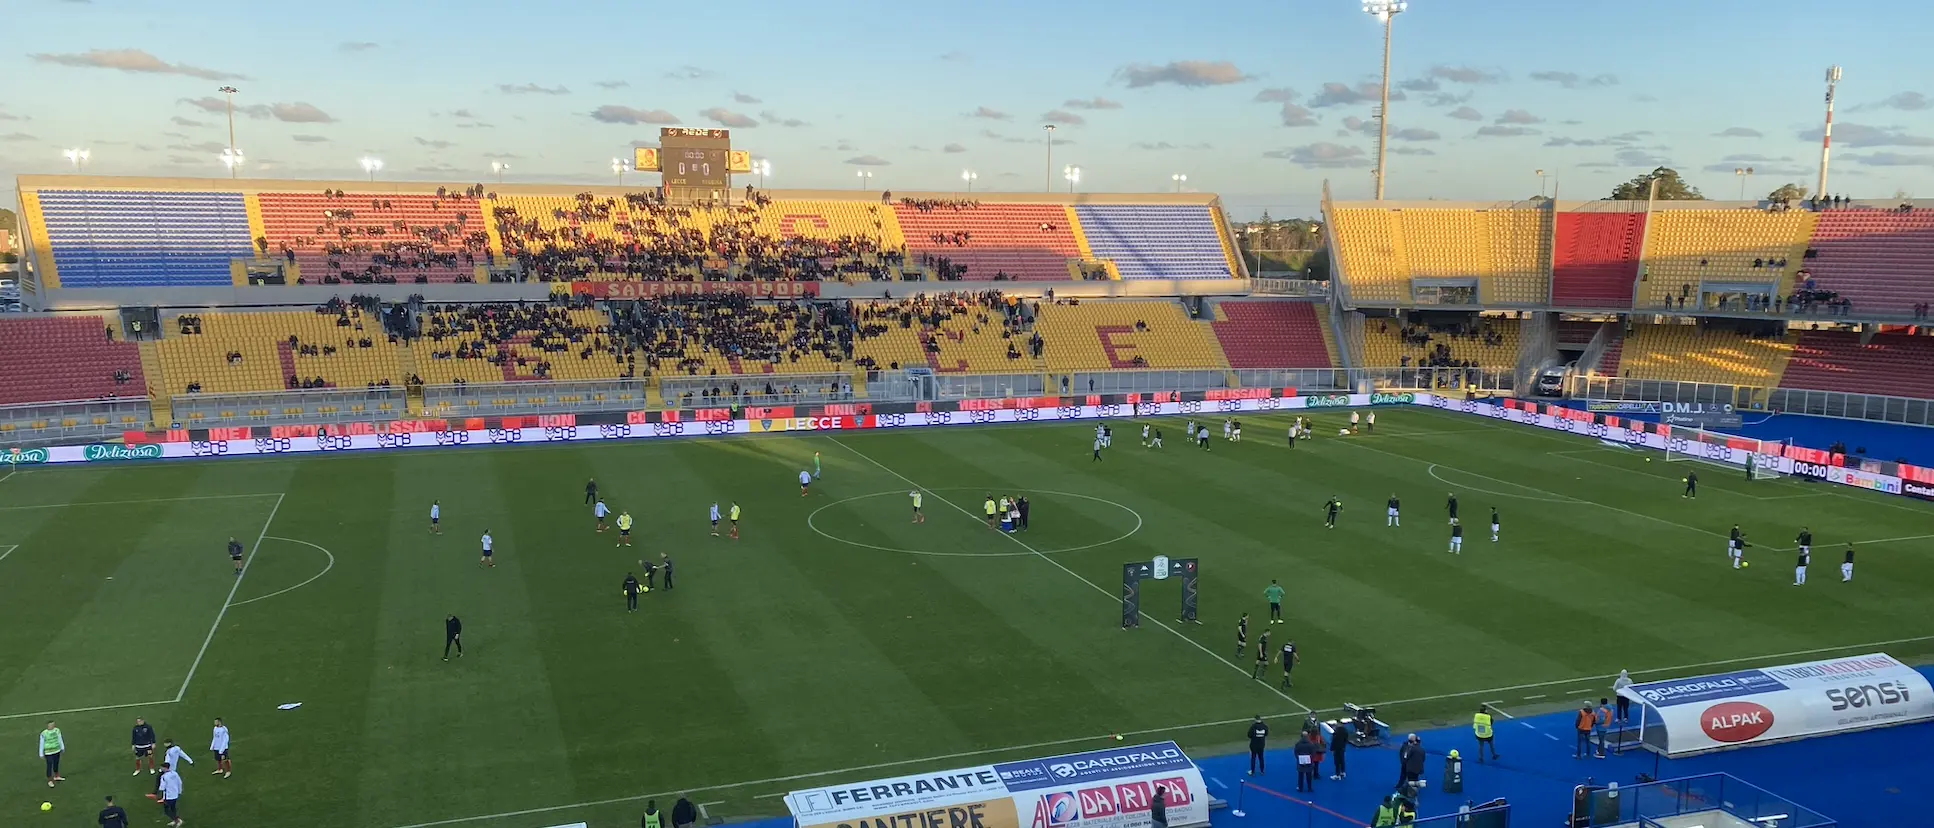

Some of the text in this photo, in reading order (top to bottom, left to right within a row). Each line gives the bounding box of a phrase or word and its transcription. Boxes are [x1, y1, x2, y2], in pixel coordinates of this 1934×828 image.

[608, 283, 703, 297] SALENTO
[750, 283, 804, 297] 1908
[1308, 396, 1348, 407] Deliziosa
[1373, 393, 1411, 404] Deliziosa
[1663, 402, 1705, 413] D.M.J.
[786, 417, 842, 431] LECCE
[92, 445, 159, 460] Deliziosa
[1795, 462, 1826, 477] 00:00
[1846, 474, 1899, 492] Bambini
[1657, 679, 1737, 696] CAROFALO
[1711, 712, 1764, 730] ALPAK
[1073, 749, 1179, 770] CAROFALO
[832, 771, 997, 805] FERRANTE
